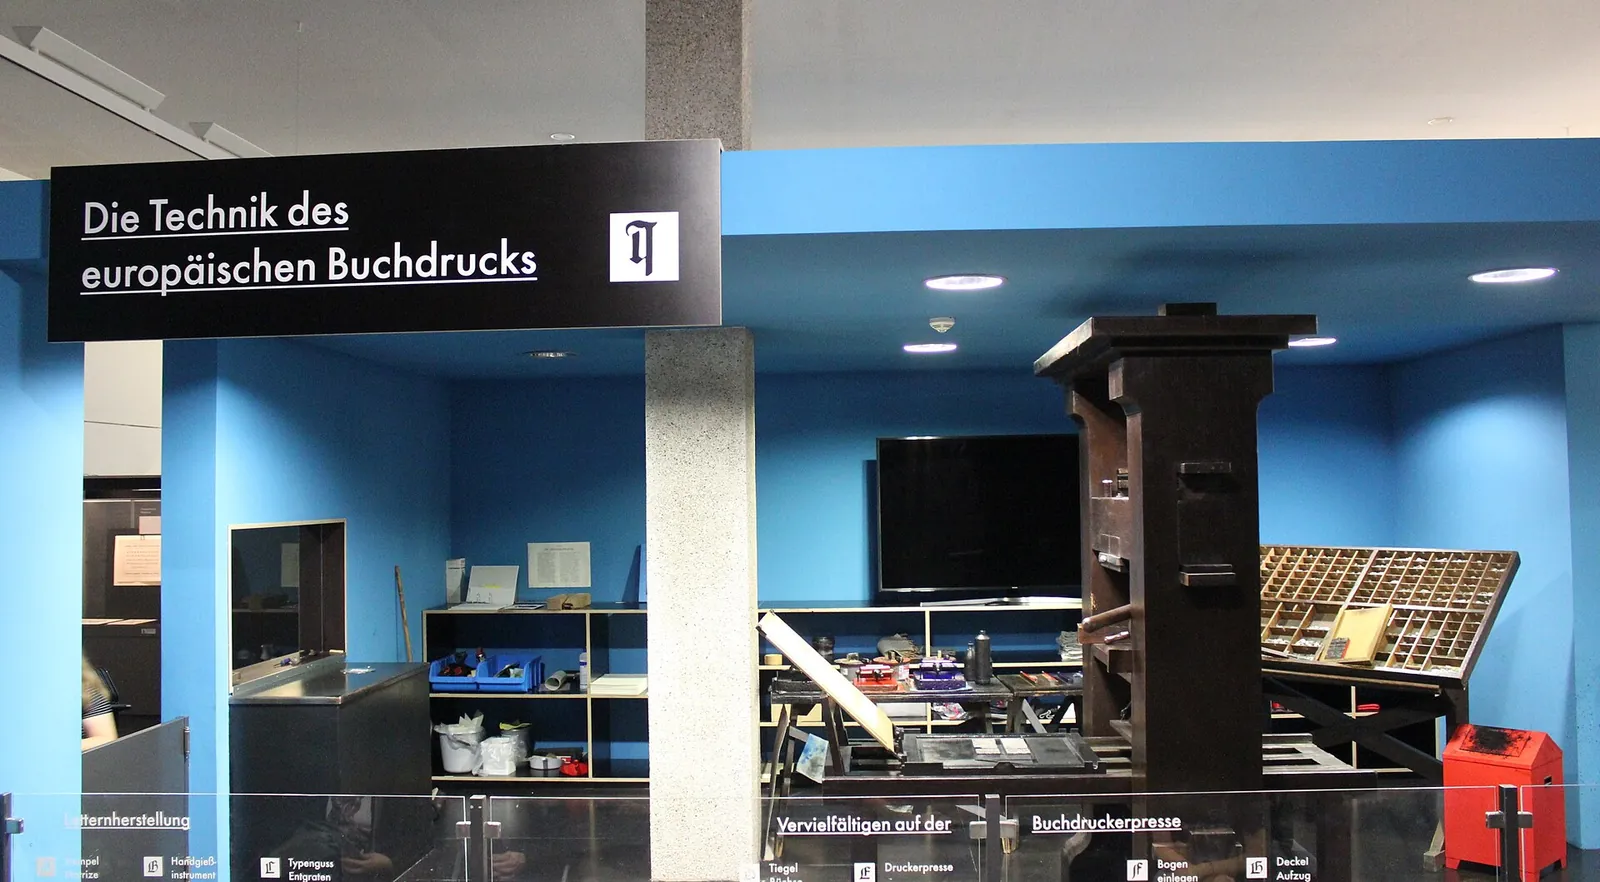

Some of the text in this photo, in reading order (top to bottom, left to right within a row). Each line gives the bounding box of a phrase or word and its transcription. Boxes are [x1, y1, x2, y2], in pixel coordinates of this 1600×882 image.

[85, 190, 348, 234] Die Technik des
[82, 238, 537, 297] europäischen Buchdrucks
[777, 814, 952, 836] Vervielfältigen auf der
[1032, 812, 1182, 832] Buchdruckerpresse
[287, 857, 335, 870] Typenguss
[884, 861, 954, 875] Druckerpresse
[1157, 859, 1189, 871] Bogen
[1276, 856, 1309, 867] Deckel
[171, 870, 217, 880] instrument
[768, 862, 798, 875] Tiegel
[288, 871, 332, 882] Entgraten
[1157, 872, 1199, 882] einlegen
[1275, 869, 1312, 882] Aufzug
